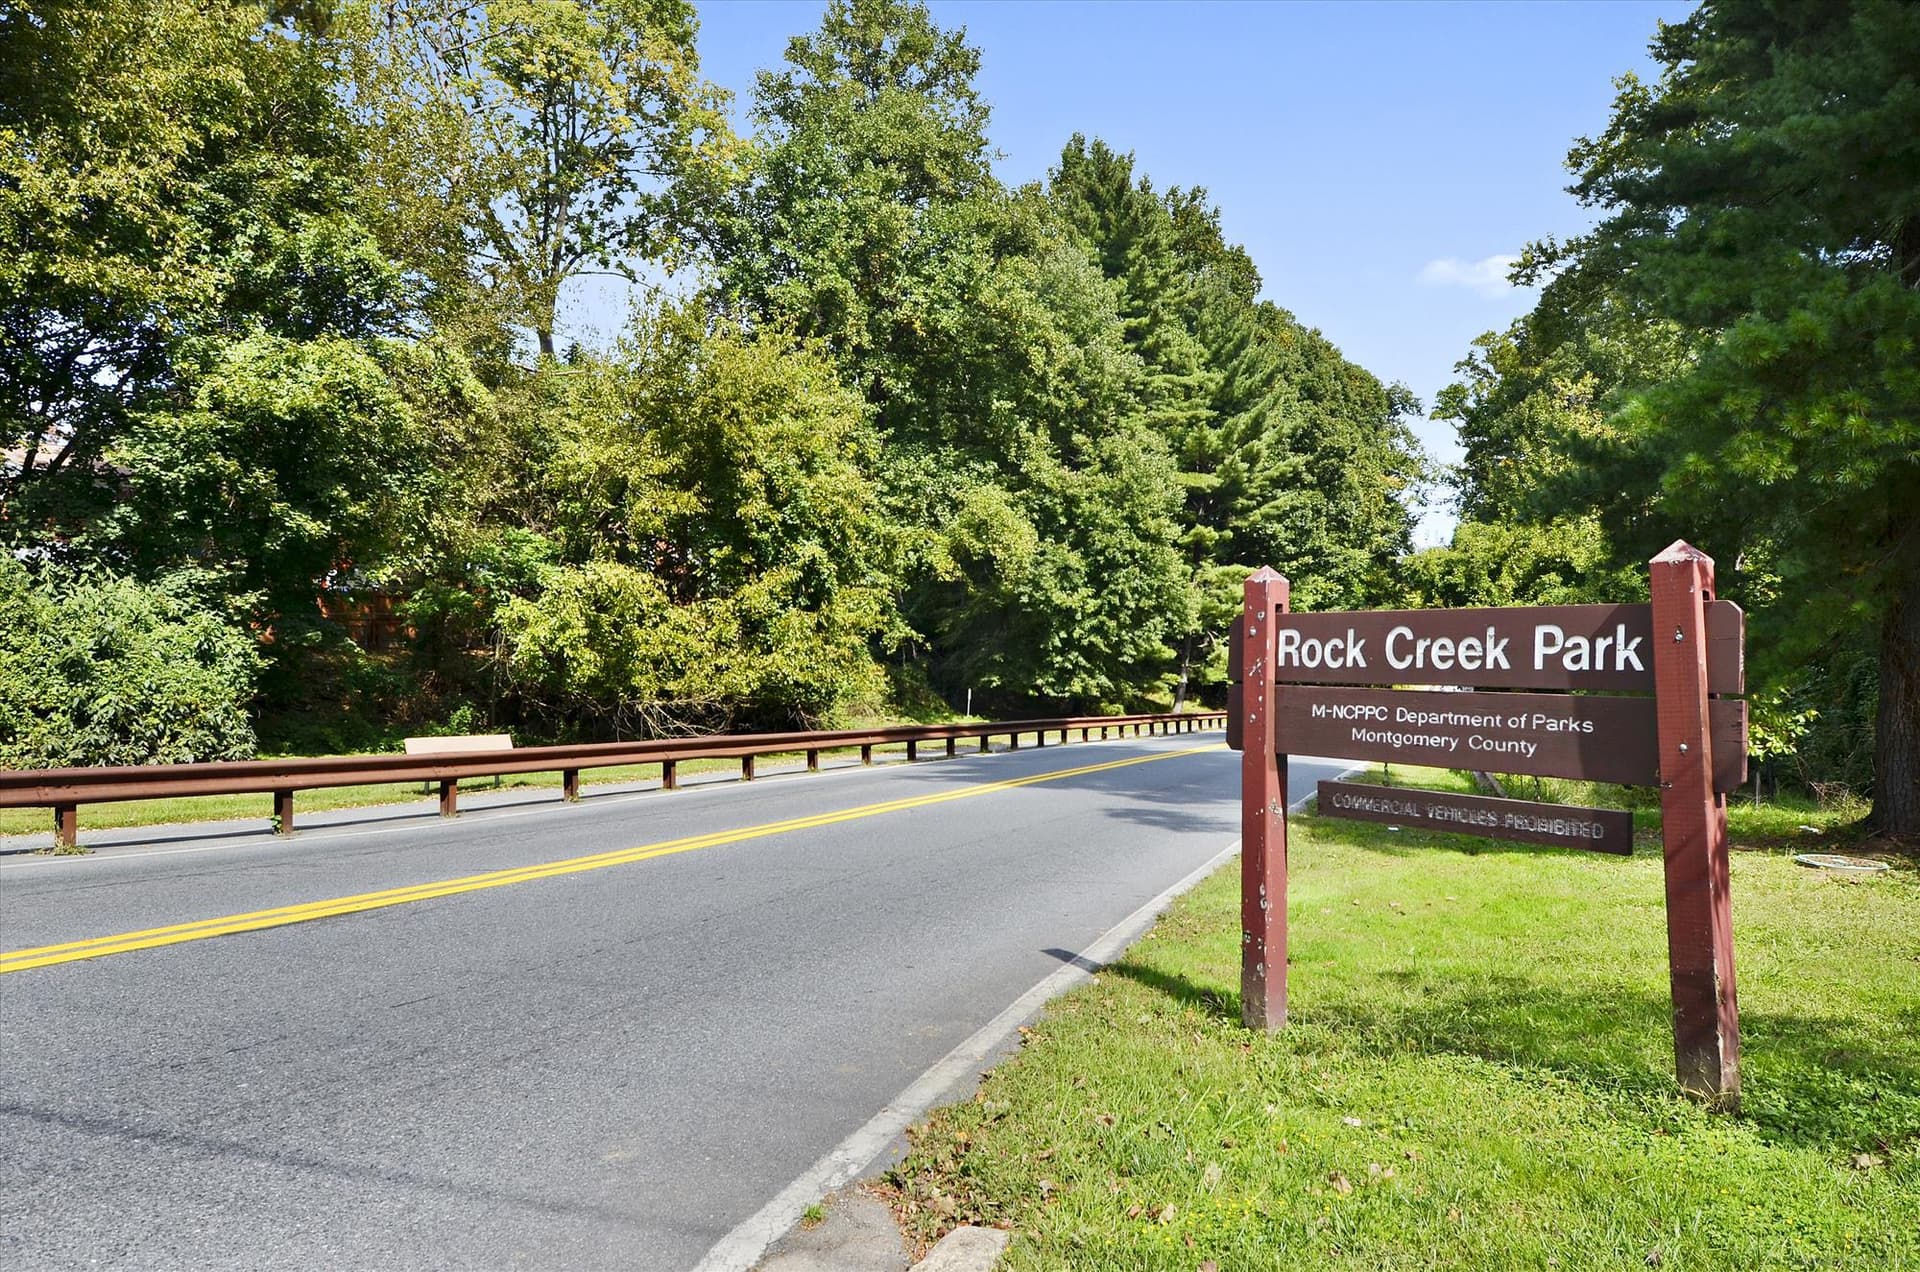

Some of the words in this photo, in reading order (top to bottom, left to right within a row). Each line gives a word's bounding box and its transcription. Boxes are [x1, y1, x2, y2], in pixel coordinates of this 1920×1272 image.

[1278, 628, 1367, 669] Rock
[1385, 625, 1511, 671] Creek
[1533, 623, 1645, 673] Park
[1311, 703, 1388, 721] M-NCPPC
[1396, 706, 1502, 728] Department
[1508, 712, 1527, 730] of
[1532, 713, 1595, 733] Parks
[1351, 727, 1459, 752] Montgomery
[1468, 734, 1538, 757] County
[1331, 792, 1421, 818] COMMERCIAL
[1427, 803, 1498, 828] VEHICLES
[1503, 813, 1605, 840] PROHIBITED
